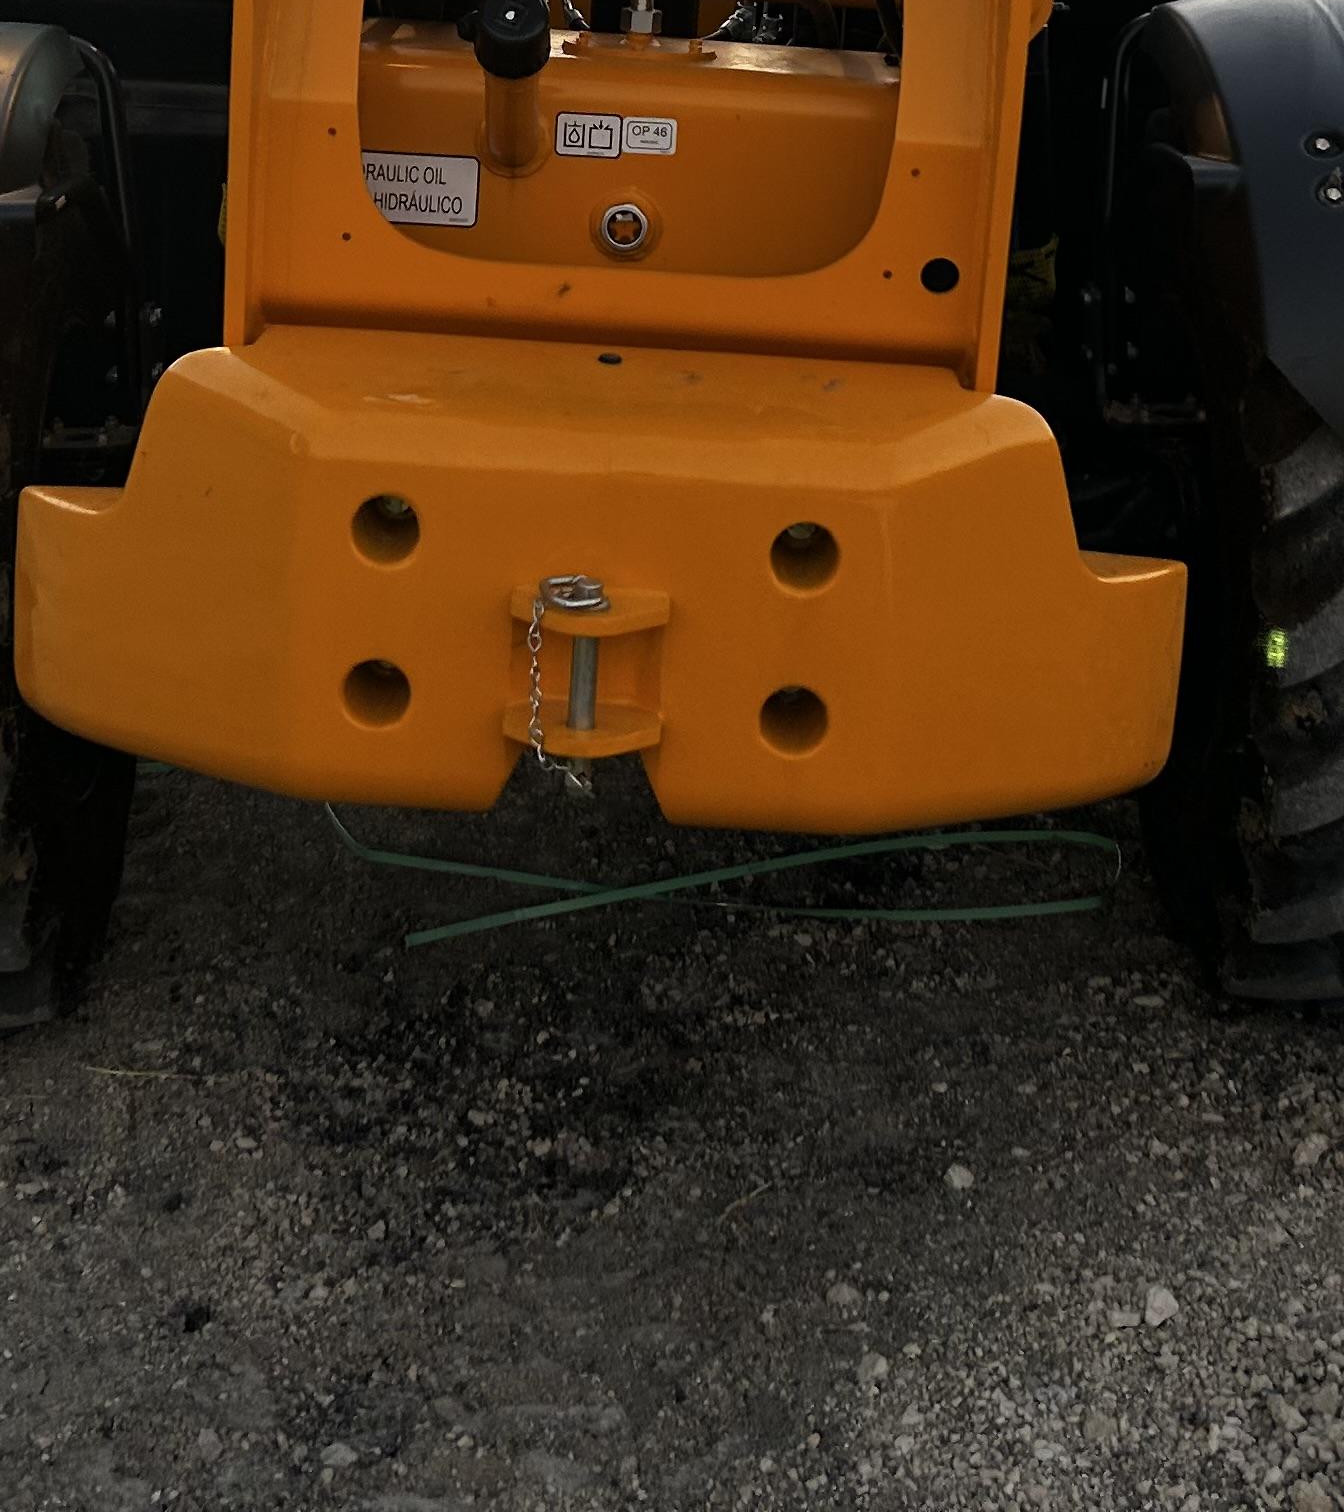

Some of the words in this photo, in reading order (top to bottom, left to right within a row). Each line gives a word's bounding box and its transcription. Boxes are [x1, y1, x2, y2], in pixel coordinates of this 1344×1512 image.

[632, 125, 650, 137] OP
[653, 127, 668, 138] 46
[363, 163, 420, 184] RAULIC
[423, 166, 447, 185] OIL
[374, 189, 463, 215] HIDRÁULICO
